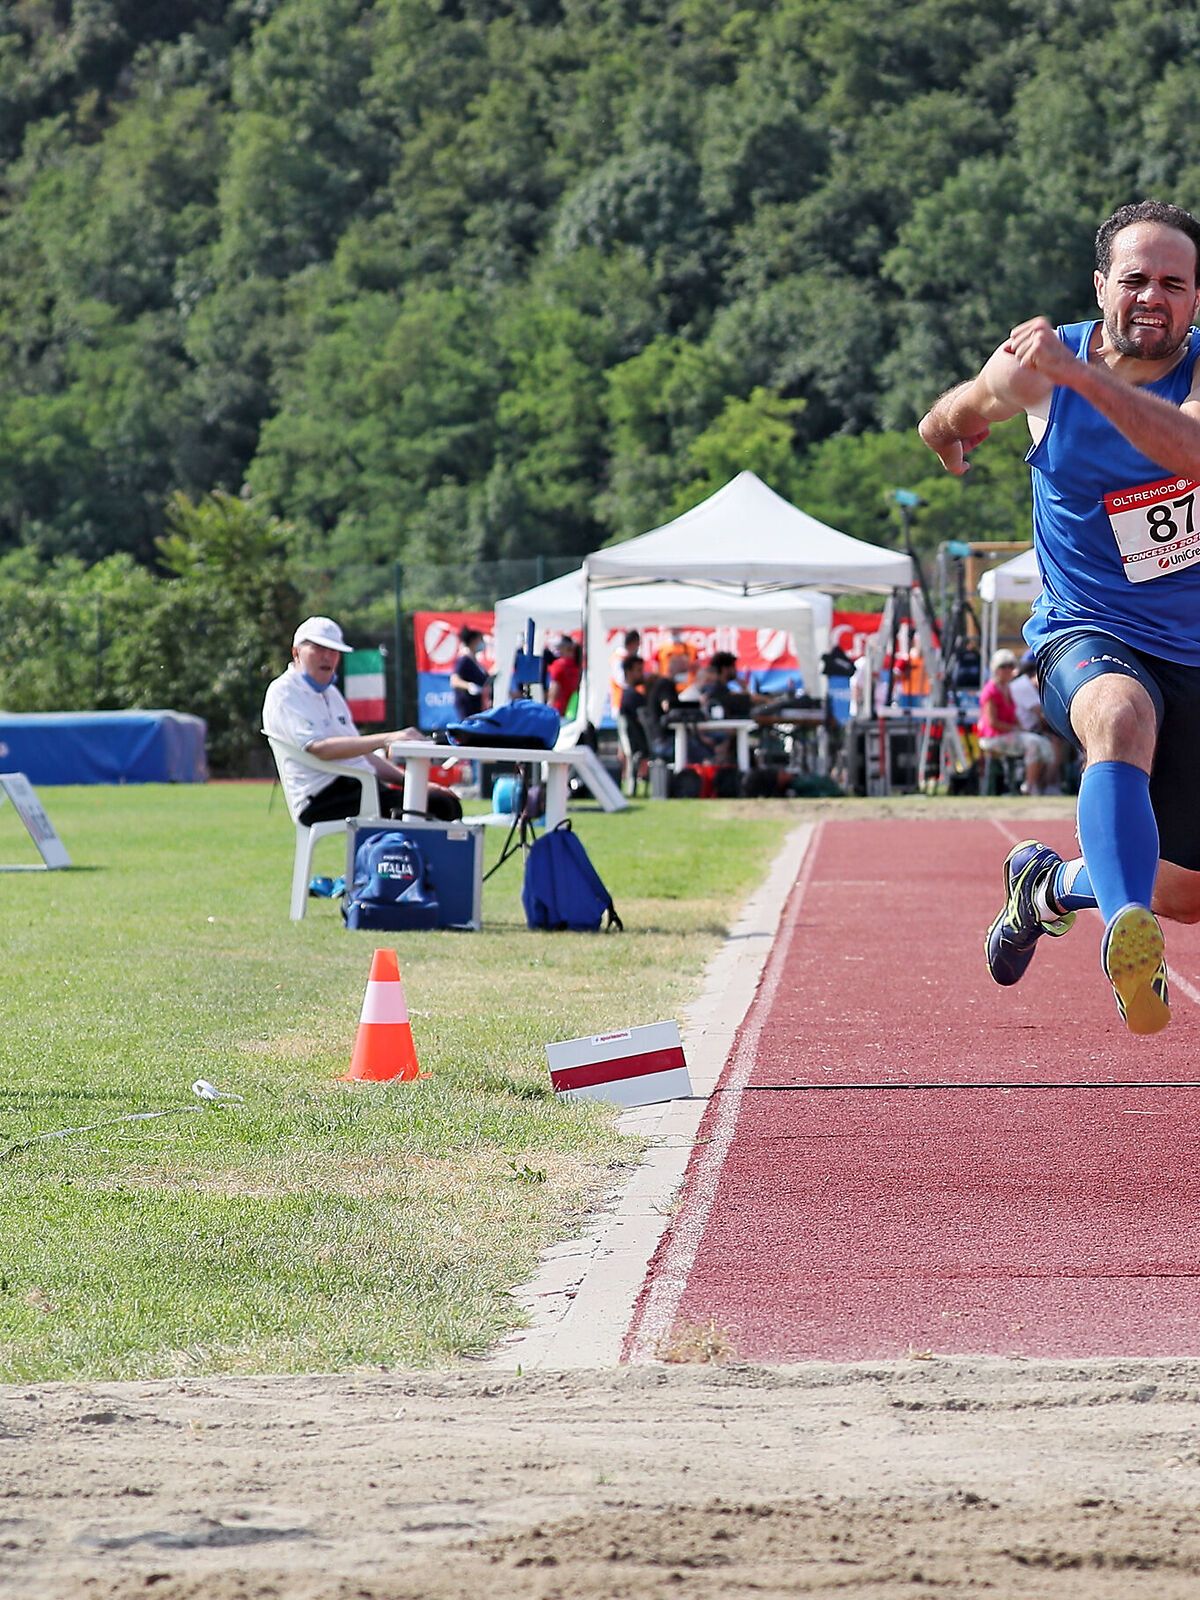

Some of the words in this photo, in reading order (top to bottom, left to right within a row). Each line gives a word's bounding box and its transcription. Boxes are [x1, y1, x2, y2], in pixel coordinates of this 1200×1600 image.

[1147, 493, 1194, 542] 87
[1127, 544, 1178, 562] CONCESIO
[378, 862, 414, 875] ITALIA
